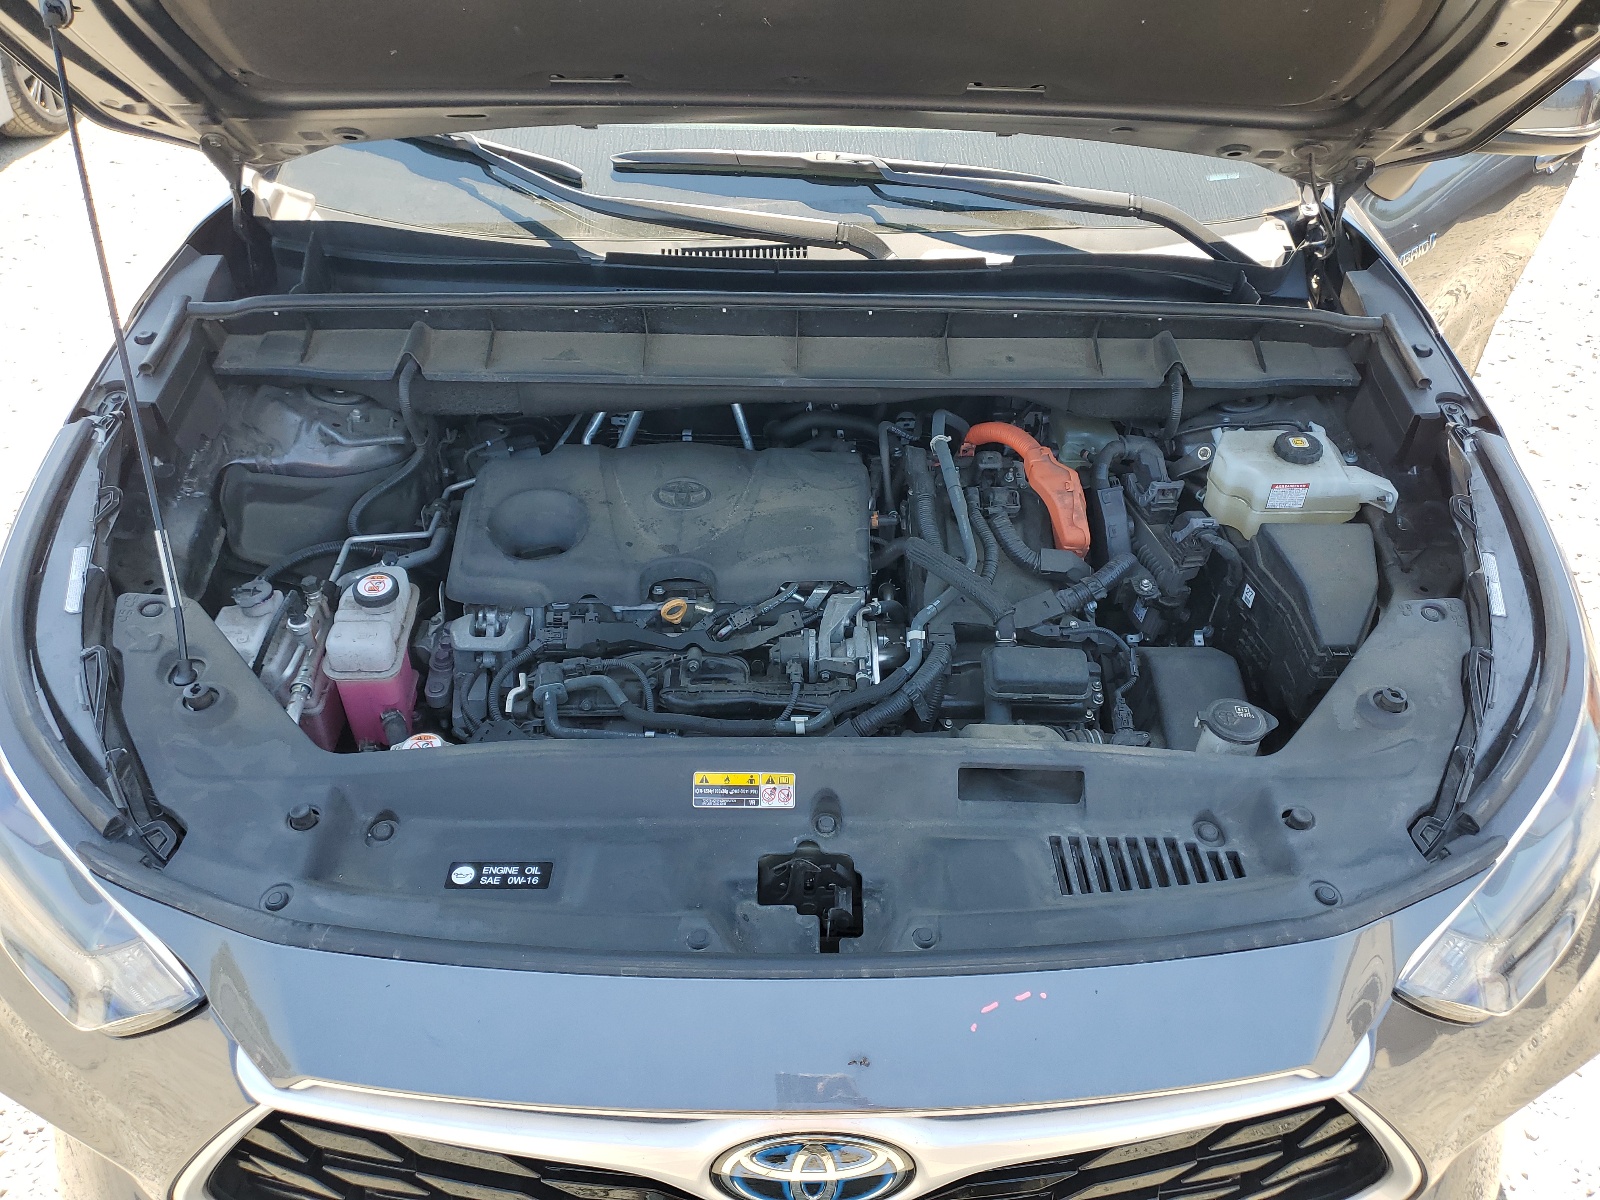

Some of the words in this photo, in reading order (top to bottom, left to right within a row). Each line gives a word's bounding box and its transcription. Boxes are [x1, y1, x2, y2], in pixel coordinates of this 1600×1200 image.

[482, 866, 519, 875] ENGINE
[525, 866, 541, 875] OIL
[479, 876, 501, 885] SAE
